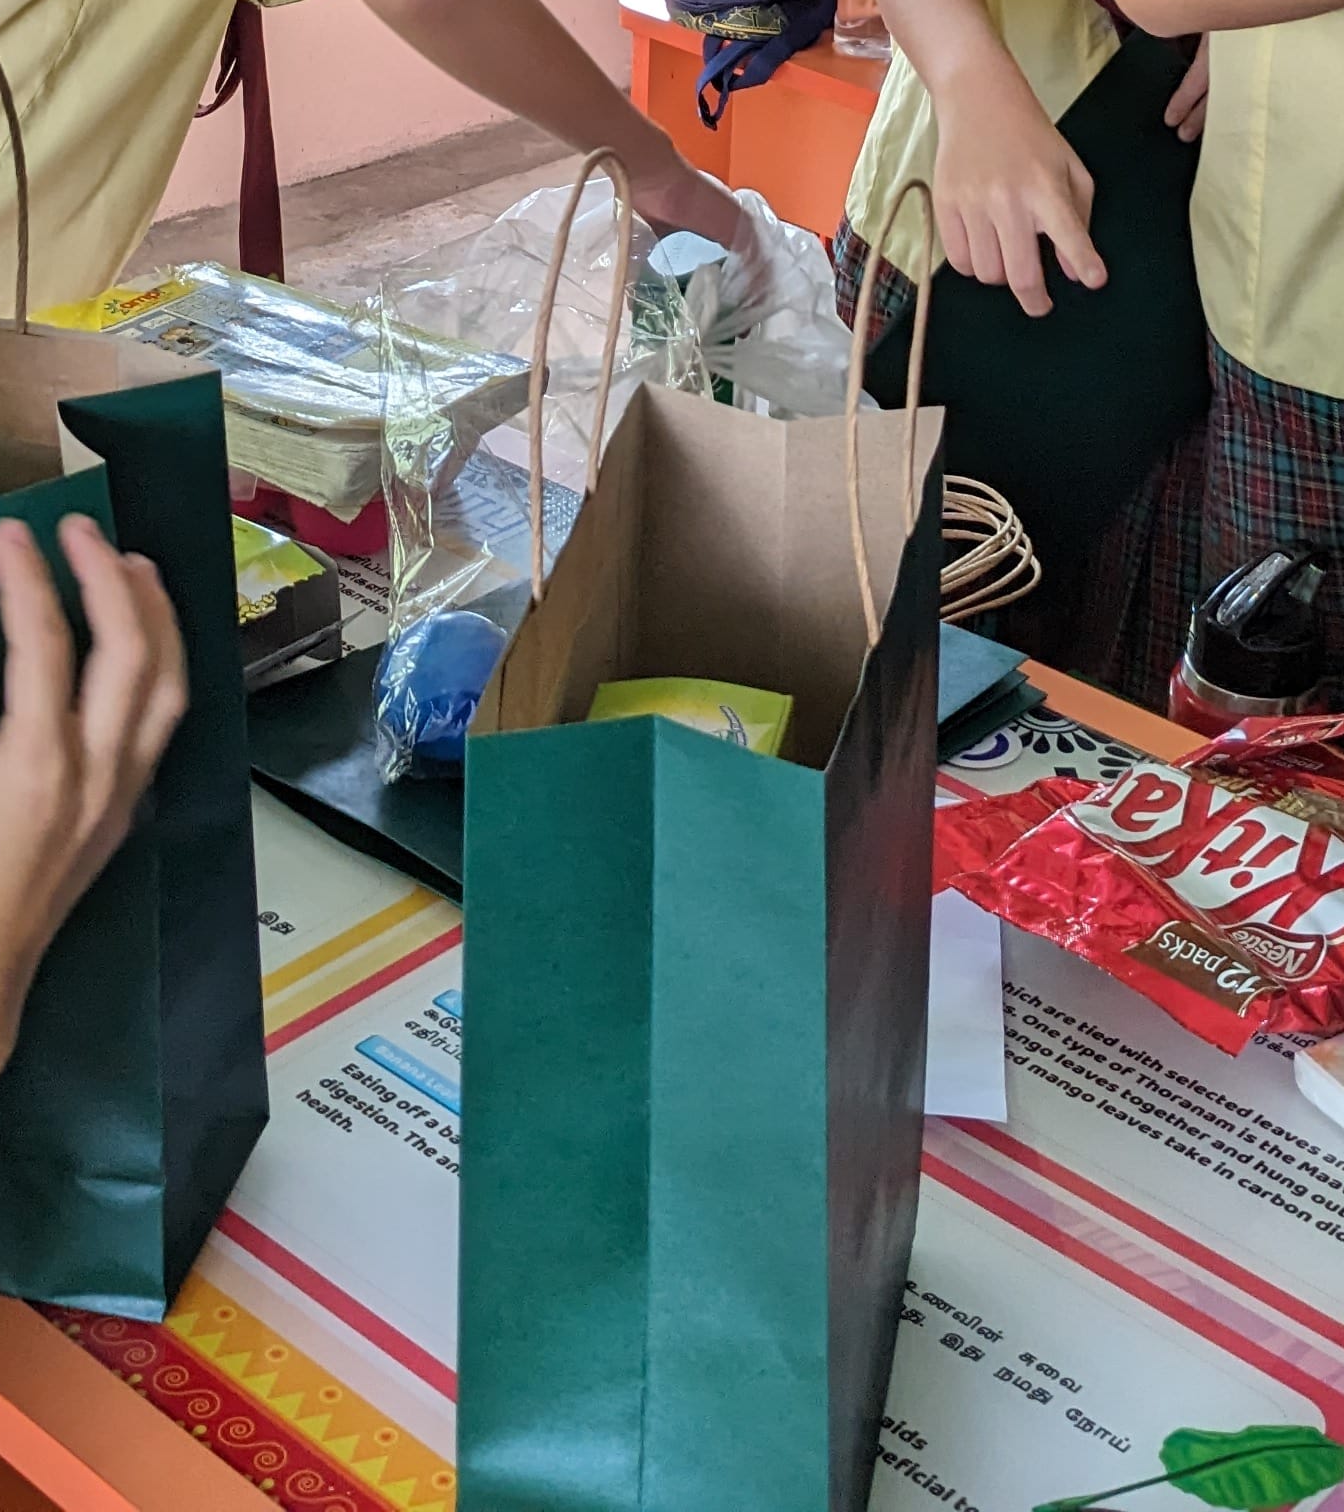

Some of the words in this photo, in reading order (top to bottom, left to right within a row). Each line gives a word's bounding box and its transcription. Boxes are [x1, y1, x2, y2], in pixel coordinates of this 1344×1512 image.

[1158, 931, 1230, 974] packs
[1215, 956, 1261, 997] 12
[295, 1088, 353, 1133] health.
[341, 1062, 397, 1103] Eating
[397, 1098, 430, 1120] off
[425, 1118, 439, 1129] a
[438, 1125, 461, 1145] ba
[1003, 982, 1042, 1011] hich
[1043, 1005, 1077, 1027] are
[1078, 1020, 1119, 1049] tied
[1120, 1042, 1163, 1073] with
[1165, 1067, 1253, 1119] selected
[1255, 1113, 1321, 1157] leaves
[1022, 1014, 1061, 1040] One
[1062, 1031, 1106, 1067] type
[1108, 1055, 1134, 1078] of
[1135, 1071, 1236, 1133] Thoranam
[1236, 1124, 1257, 1145] is
[1259, 1137, 1295, 1165] the
[319, 1077, 399, 1136] digestion.
[404, 1131, 438, 1158] The
[1003, 1047, 1028, 1068] ed
[1029, 1065, 1096, 1104] mango
[1097, 1098, 1163, 1140] leaves
[1165, 1135, 1212, 1167] take
[1213, 1160, 1236, 1181] in
[1237, 1175, 1314, 1224] carbon
[1004, 1027, 1054, 1060] ango
[1055, 1048, 1120, 1093] leaves
[1121, 1087, 1211, 1146] together
[1211, 1137, 1252, 1166] and
[1252, 1159, 1309, 1199] hung
[900, 1304, 924, 1327] து.
[939, 1332, 986, 1362] இது
[993, 1366, 1054, 1406] நமது
[876, 1444, 955, 1502] eficial
[880, 1416, 928, 1452] aids
